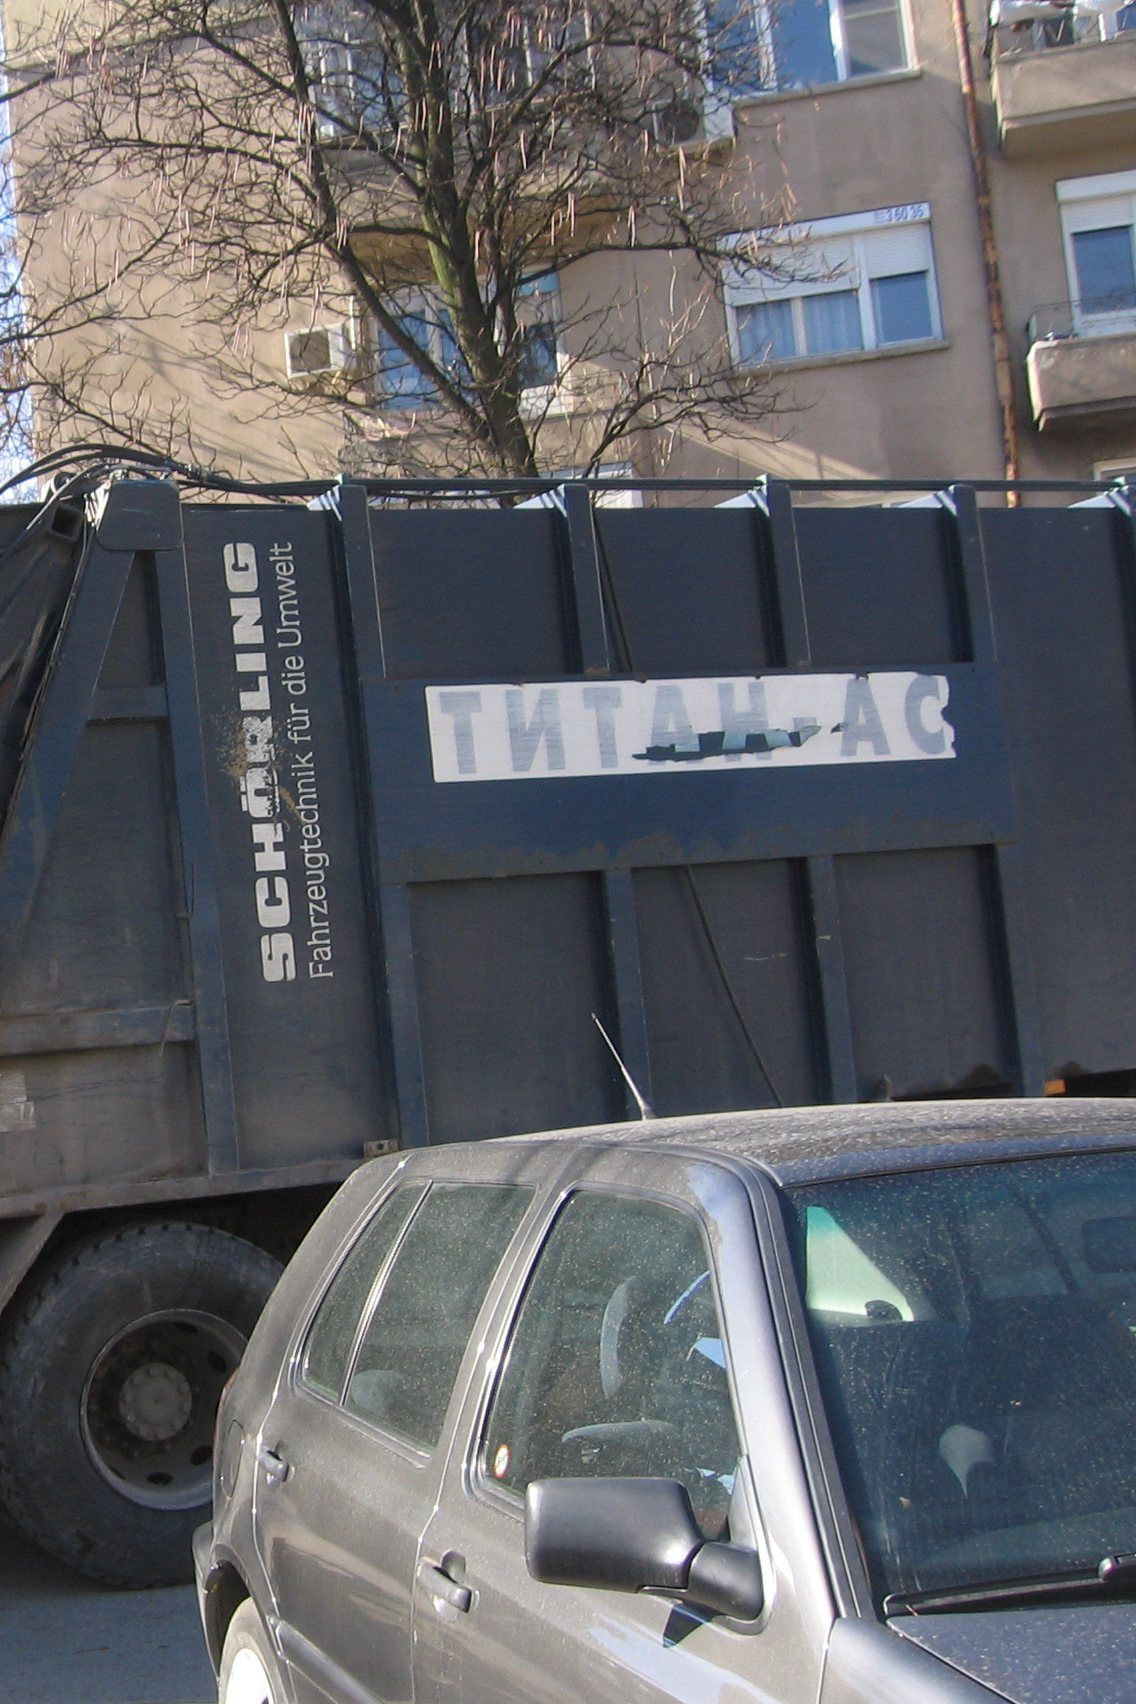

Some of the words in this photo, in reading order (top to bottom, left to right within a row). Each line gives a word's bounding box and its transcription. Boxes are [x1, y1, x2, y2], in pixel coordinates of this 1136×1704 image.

[269, 541, 302, 648] Umwelt
[281, 655, 307, 695] die
[287, 702, 312, 744] für
[223, 542, 296, 982] SCHÖRLING
[291, 751, 333, 979] Fahrzeugtechnik
